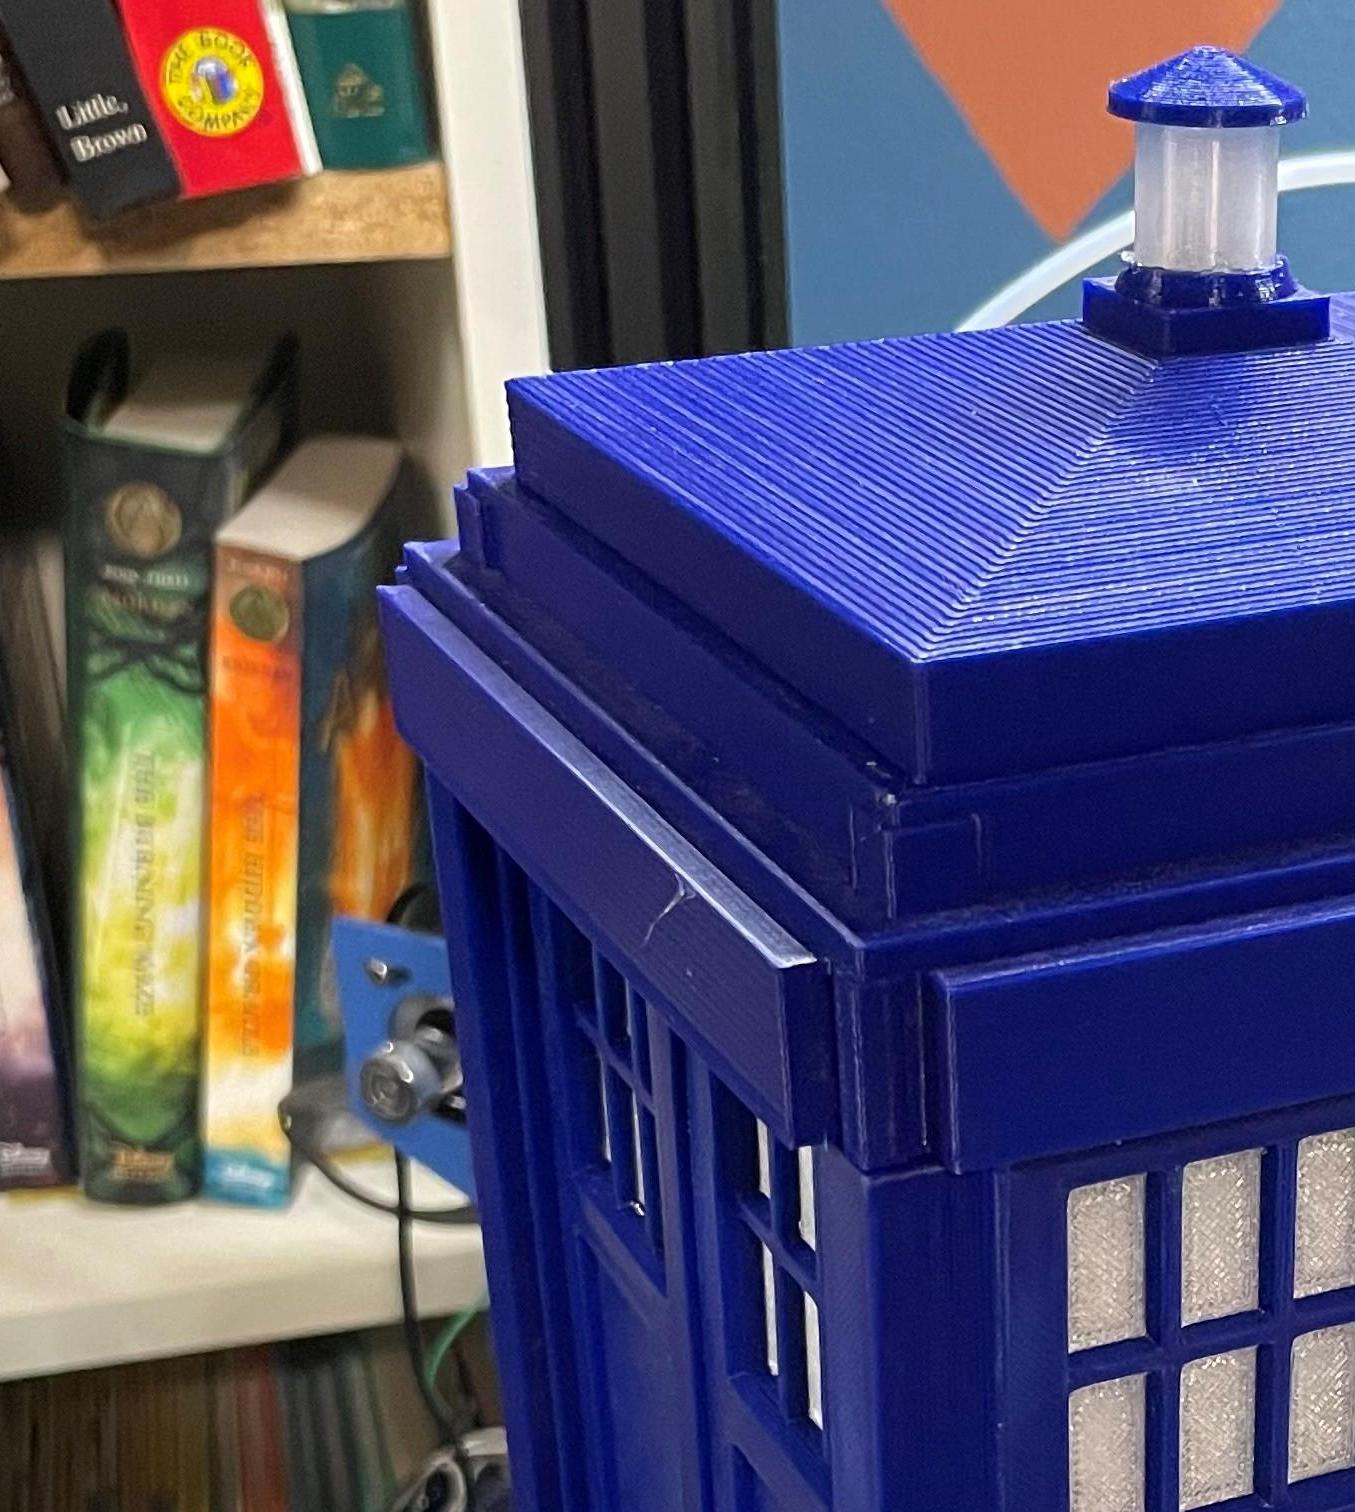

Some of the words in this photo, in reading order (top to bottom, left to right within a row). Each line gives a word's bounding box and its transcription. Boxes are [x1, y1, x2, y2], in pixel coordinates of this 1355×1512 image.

[167, 43, 192, 84] THE
[198, 31, 253, 67] BOOK
[56, 93, 129, 130] Little,
[176, 88, 261, 131] COMPANY
[69, 123, 148, 162] Brown
